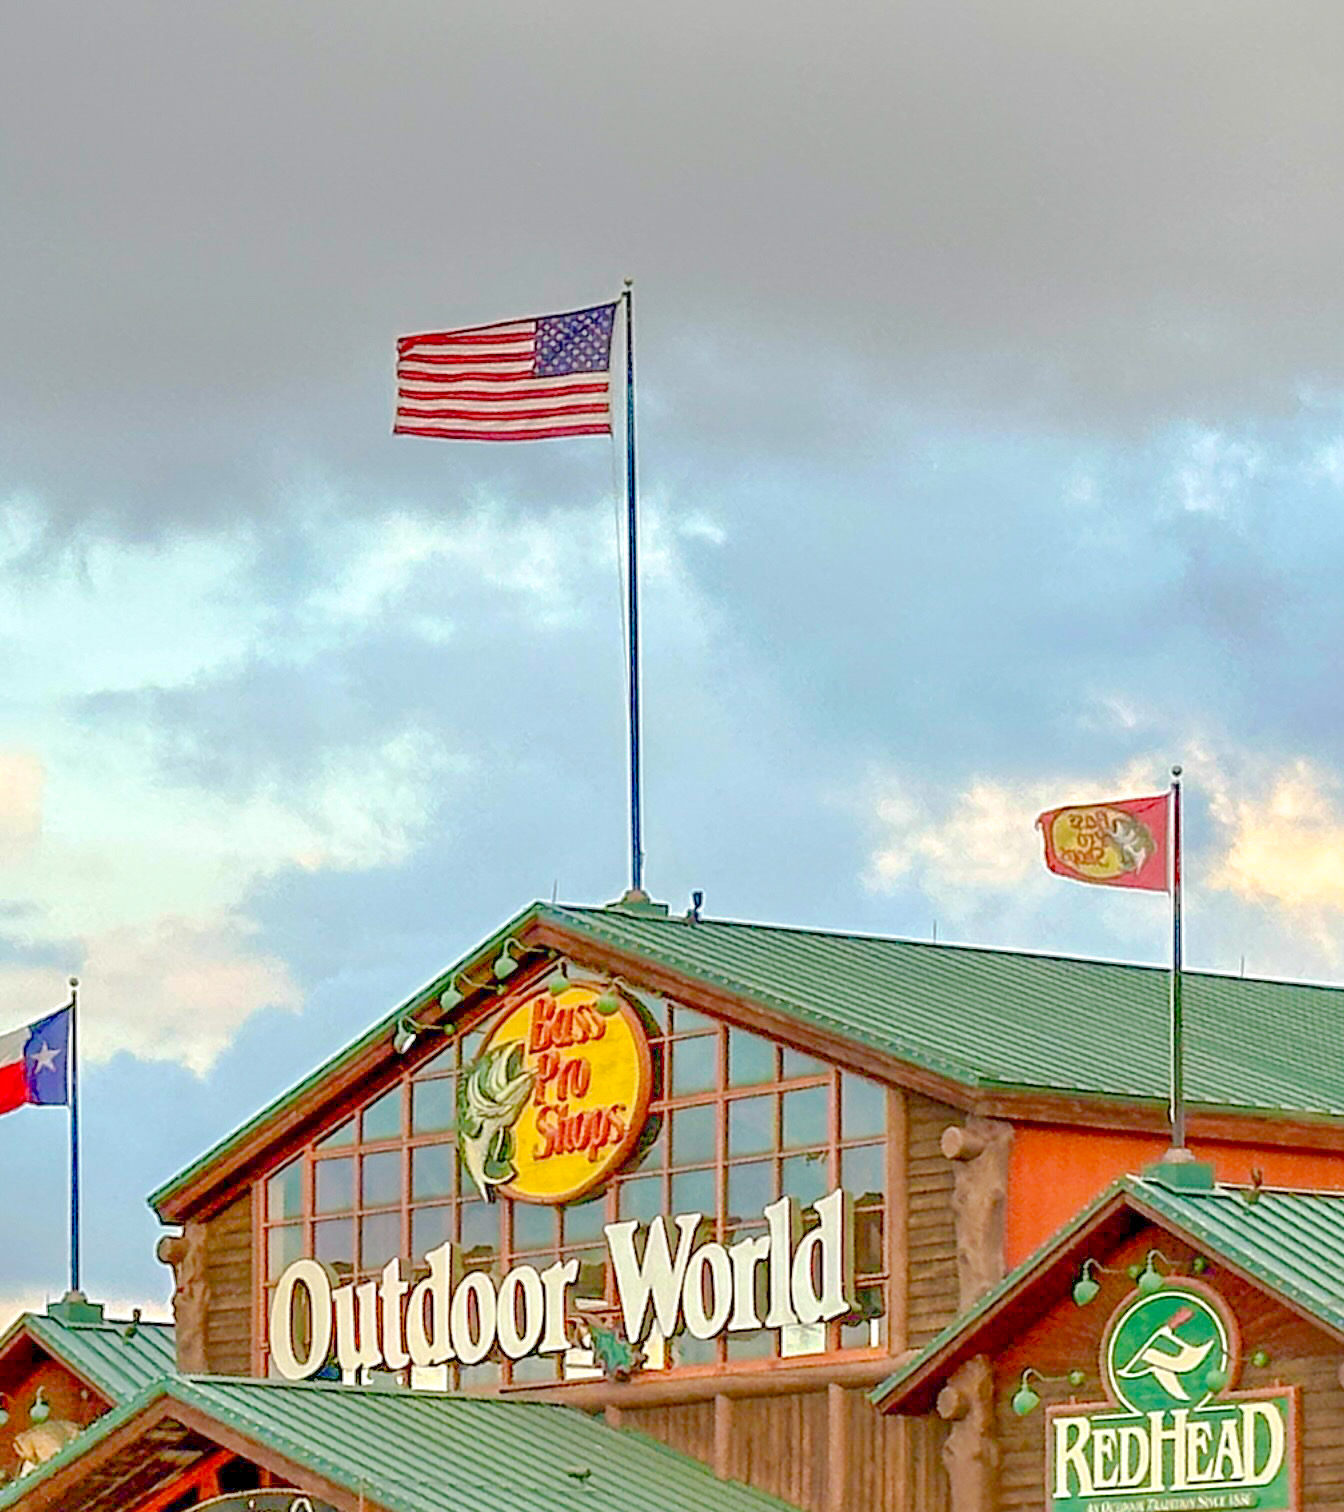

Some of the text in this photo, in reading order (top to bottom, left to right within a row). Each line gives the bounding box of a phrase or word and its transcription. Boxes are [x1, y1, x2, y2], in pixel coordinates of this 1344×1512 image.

[529, 998, 606, 1053] Bass
[533, 1051, 592, 1106] Pro
[533, 1103, 627, 1163] Shops
[270, 1188, 851, 1380] Outdoor World
